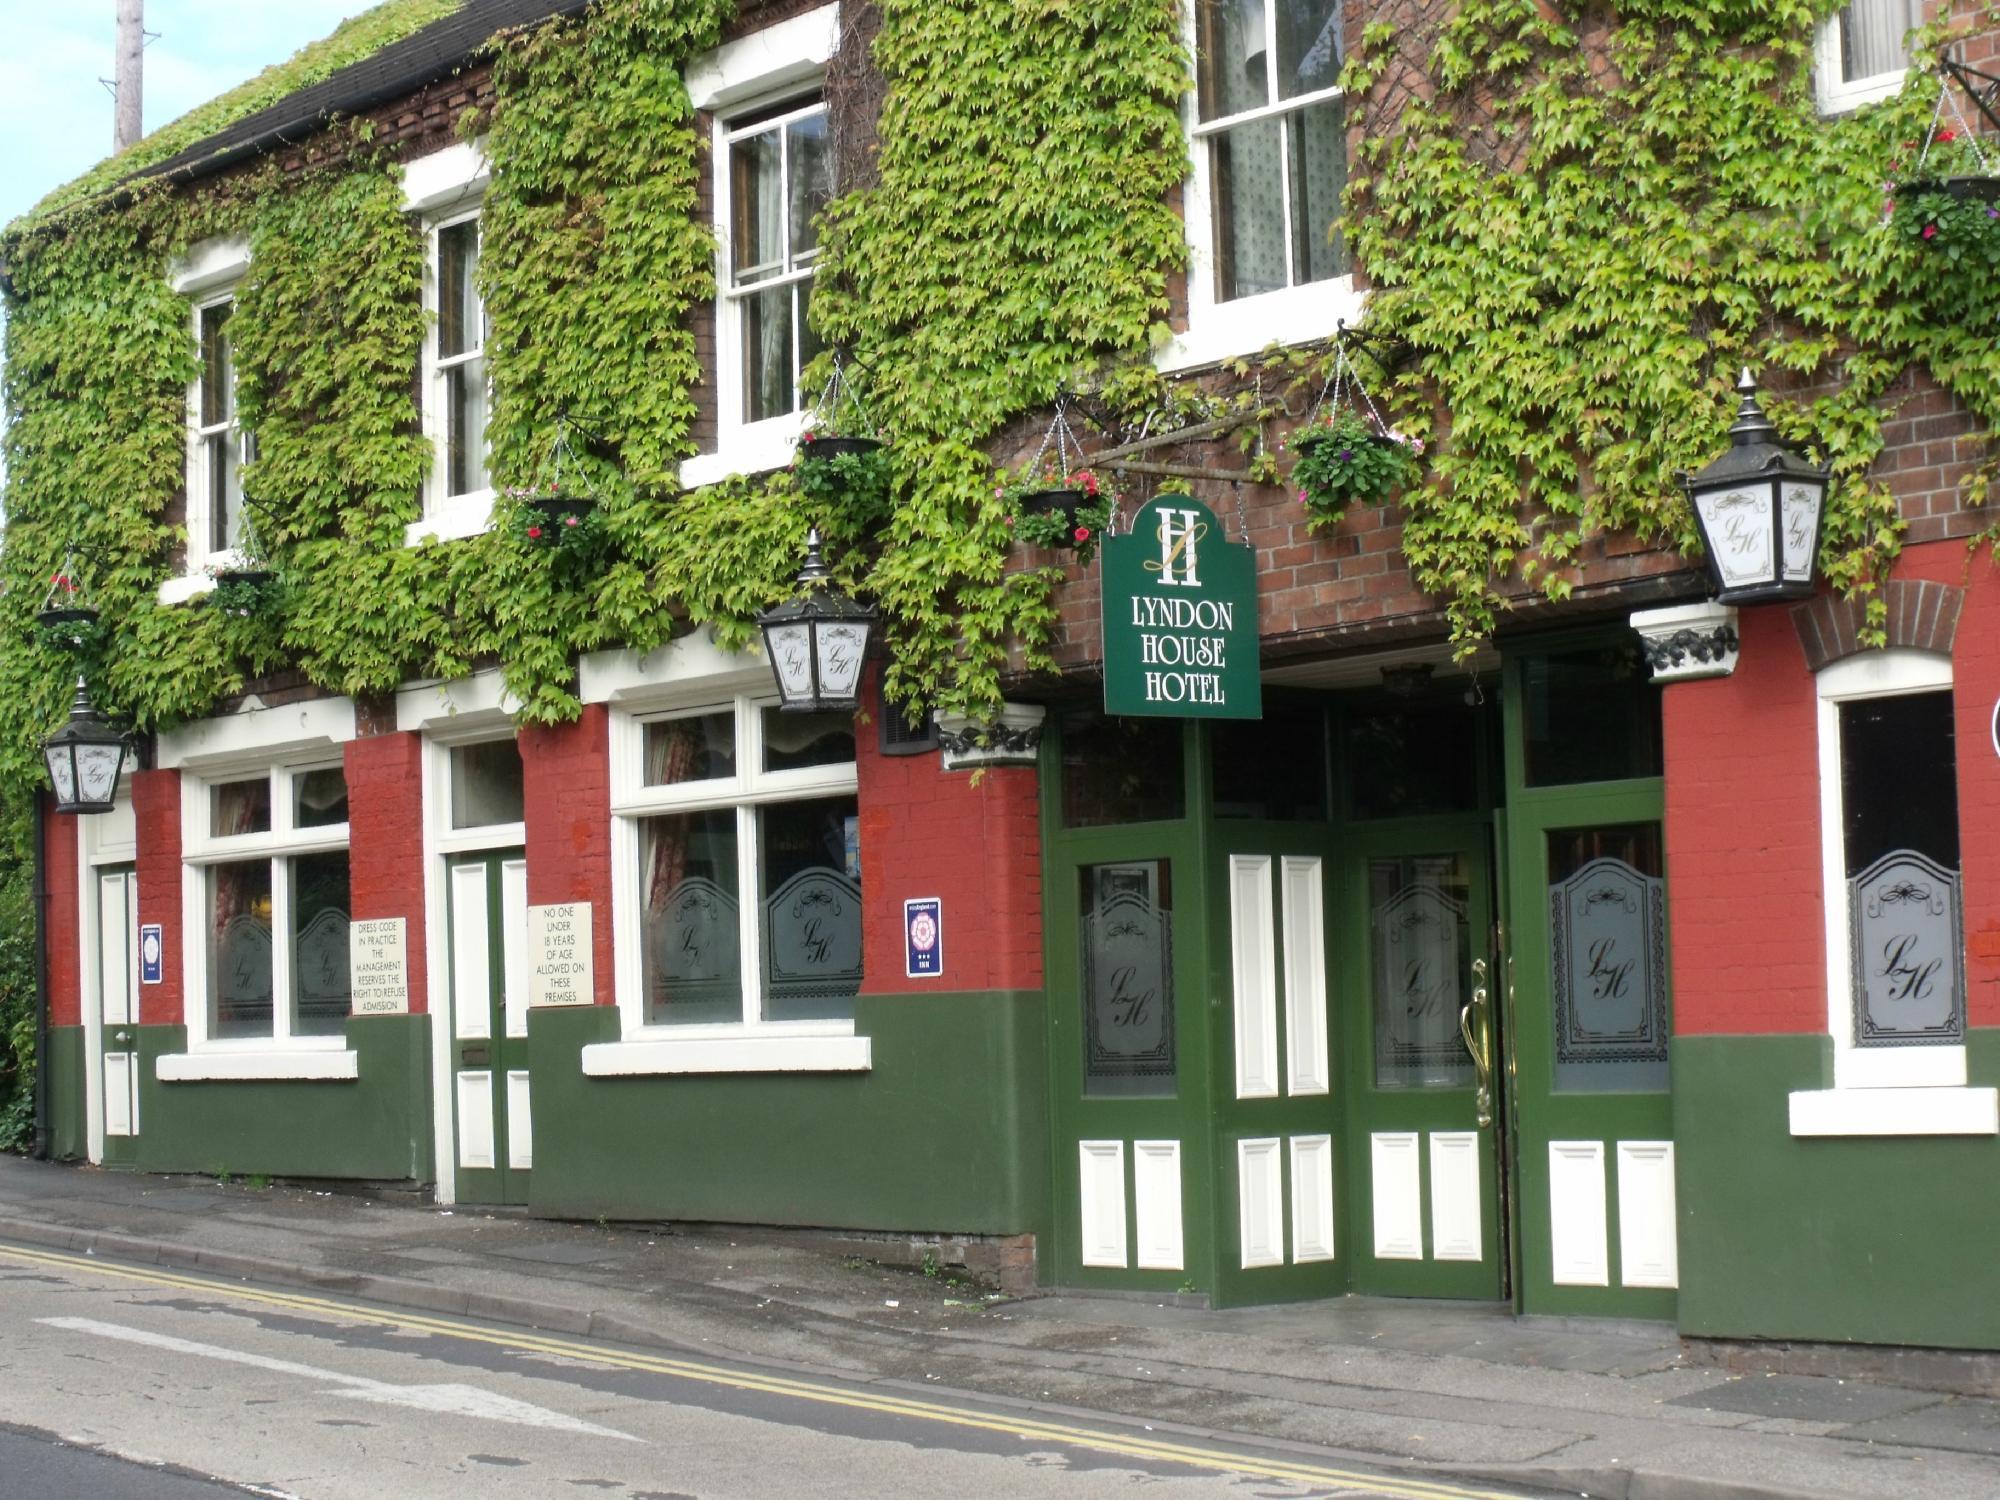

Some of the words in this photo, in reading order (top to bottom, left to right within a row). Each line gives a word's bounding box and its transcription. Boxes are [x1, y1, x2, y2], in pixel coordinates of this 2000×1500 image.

[1131, 596, 1234, 631] LYNDON
[1141, 634, 1226, 668] HOUSE
[1145, 672, 1225, 705] HOTEL
[544, 908, 556, 918] NO
[558, 907, 574, 917] ONE
[358, 923, 377, 934] DRESS
[379, 922, 397, 932] CODE
[547, 921, 571, 932] UNDER
[359, 938, 366, 946] IN
[368, 935, 397, 945] PRACTICE
[544, 937, 551, 947] 18
[553, 935, 575, 946] YEARS
[372, 949, 384, 959] THE
[546, 950, 556, 960] OF
[559, 949, 573, 959] AGE
[356, 961, 401, 972] MANAGEMENT
[536, 963, 570, 975] ALLOWED
[572, 963, 585, 973] ON
[919, 960, 930, 969] INN
[358, 975, 386, 986] RESERVES
[388, 974, 400, 984] THE
[550, 977, 571, 988] THESE
[353, 989, 371, 999] RIGHT
[373, 988, 381, 998] TO
[383, 987, 406, 997] REFUSE
[545, 991, 577, 1003] PREMISES
[362, 1001, 398, 1011] ADMISSION
